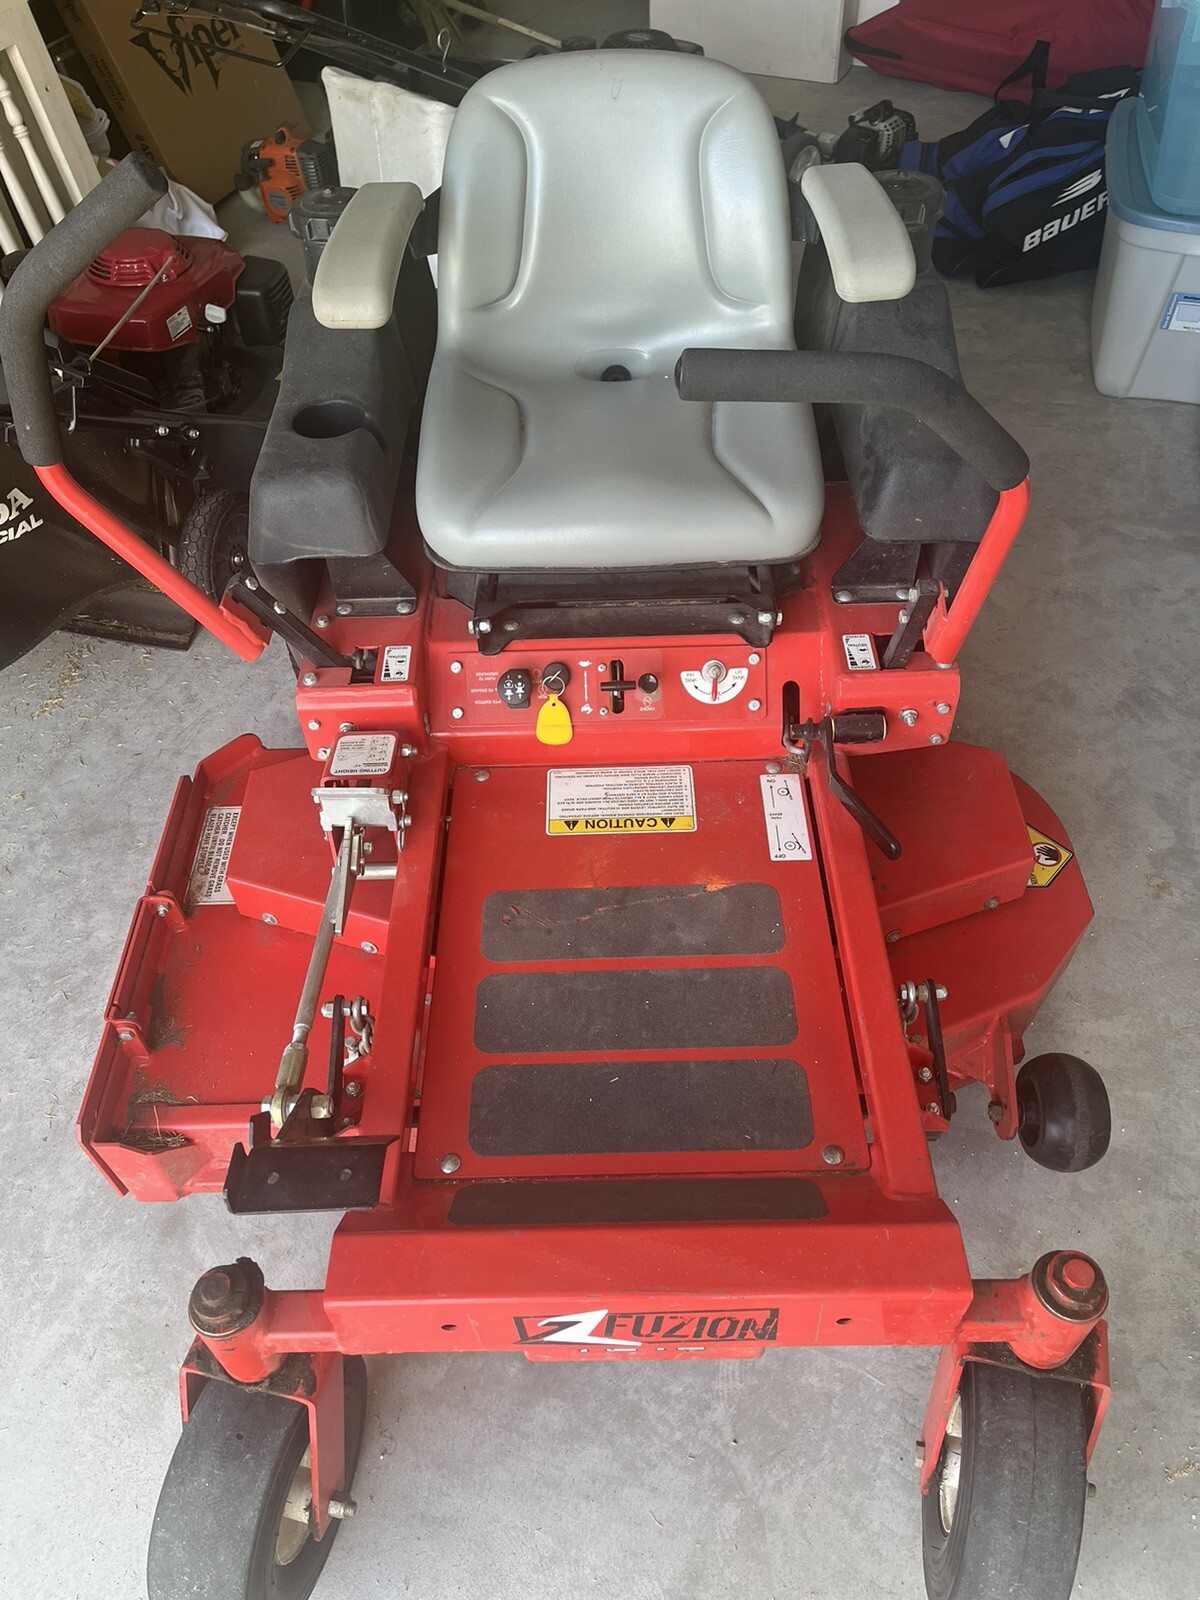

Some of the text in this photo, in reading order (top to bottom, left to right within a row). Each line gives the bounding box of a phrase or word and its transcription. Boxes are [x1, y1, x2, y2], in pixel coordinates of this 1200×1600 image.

[100, 58, 126, 101] HIDEAWAY
[213, 813, 224, 834] CATCHER
[230, 813, 239, 830] EXCEPT
[585, 818, 657, 829] CAUTION
[210, 858, 220, 878] REMOVE
[219, 861, 227, 874] WITH
[214, 875, 224, 893] GRASS
